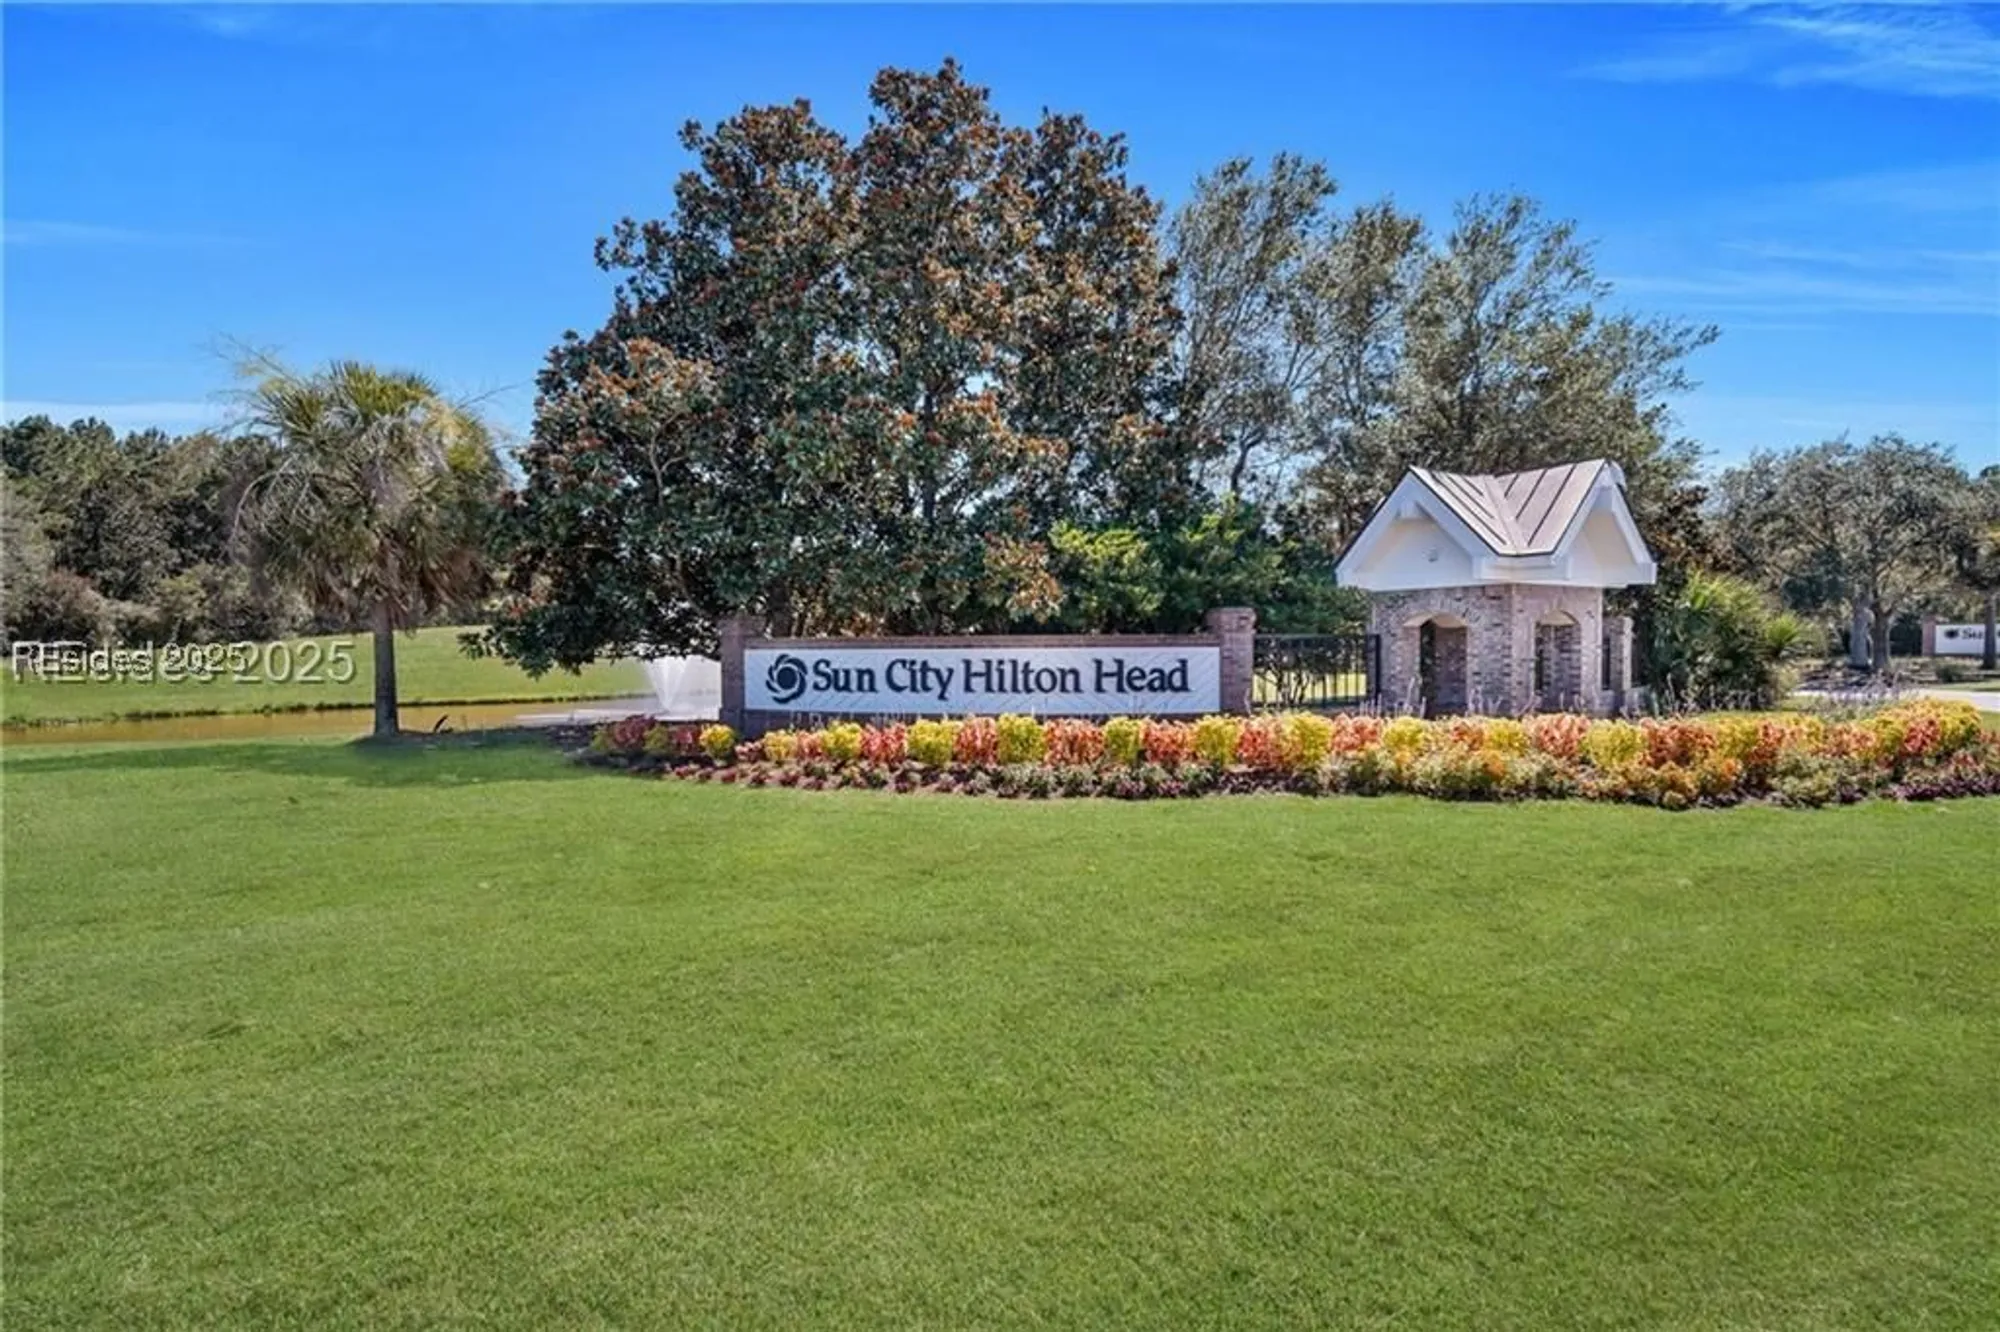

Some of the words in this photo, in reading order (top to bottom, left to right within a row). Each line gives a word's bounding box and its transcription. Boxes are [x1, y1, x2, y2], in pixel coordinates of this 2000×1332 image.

[811, 658, 878, 693] Sun
[885, 658, 955, 701] City
[961, 658, 1083, 694] Hilton
[1092, 658, 1192, 694] Head
